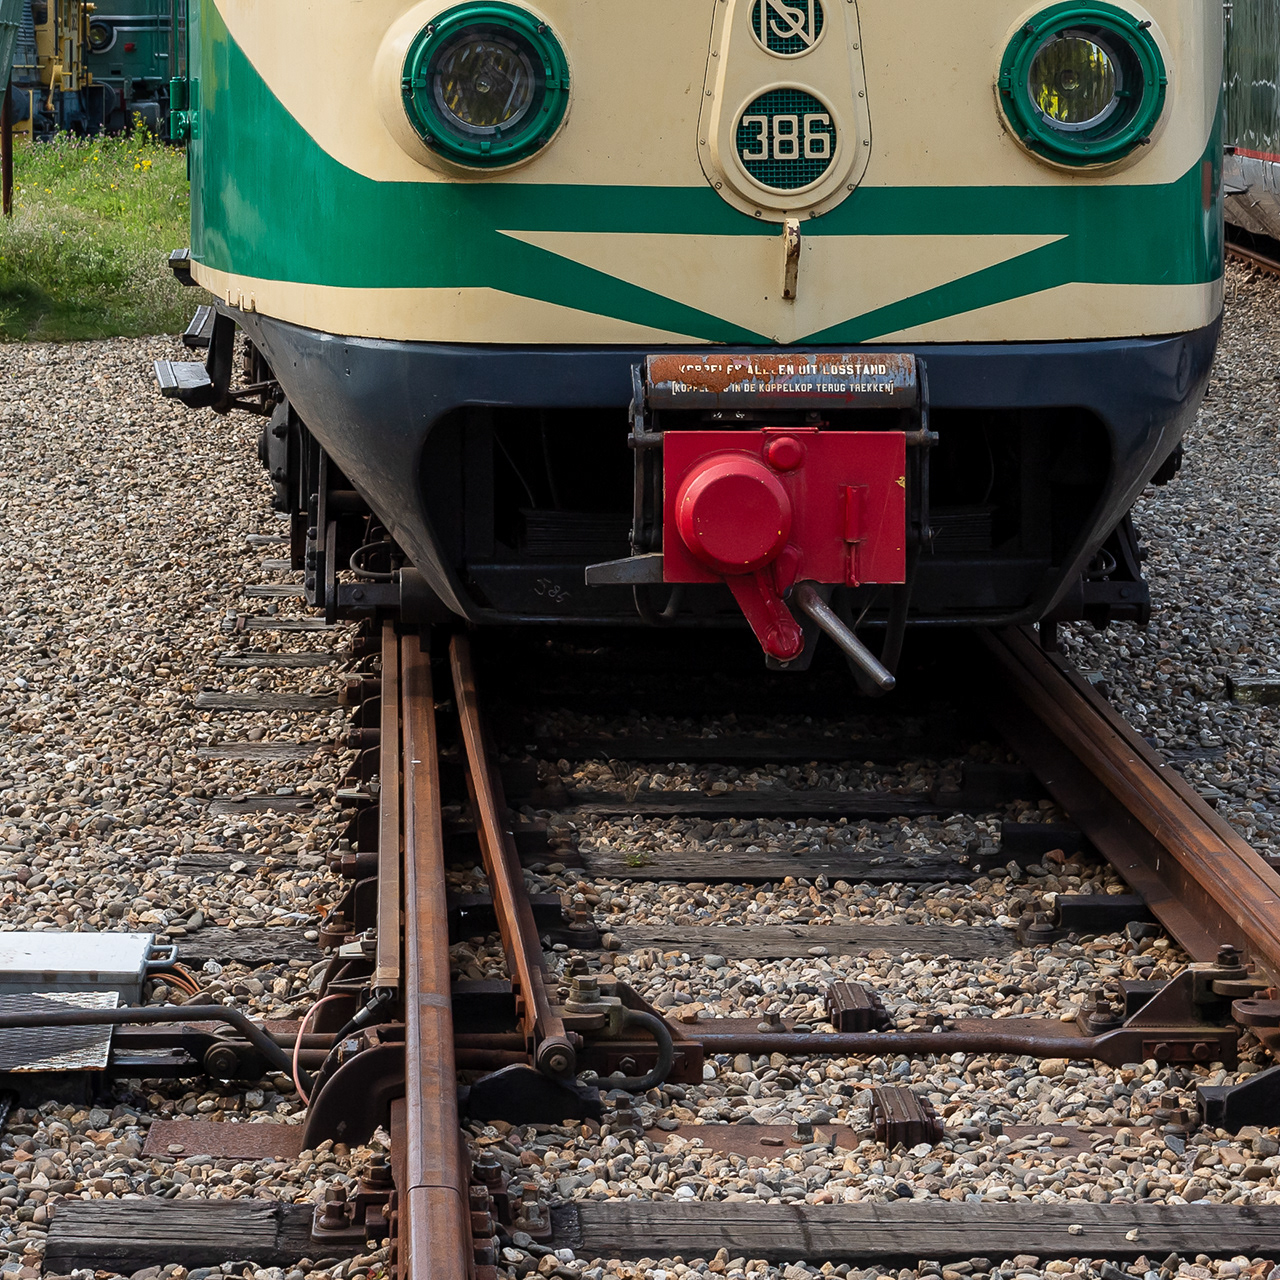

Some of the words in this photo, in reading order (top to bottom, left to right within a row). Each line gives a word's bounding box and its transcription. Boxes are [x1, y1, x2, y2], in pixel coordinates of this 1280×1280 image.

[742, 113, 830, 161] 386
[798, 364, 818, 375] UIT
[823, 364, 886, 375] LOSSTAND
[732, 383, 741, 393] IN
[744, 383, 756, 393] DE
[759, 383, 813, 393] KOPPELKOP
[816, 383, 846, 393] TERUG
